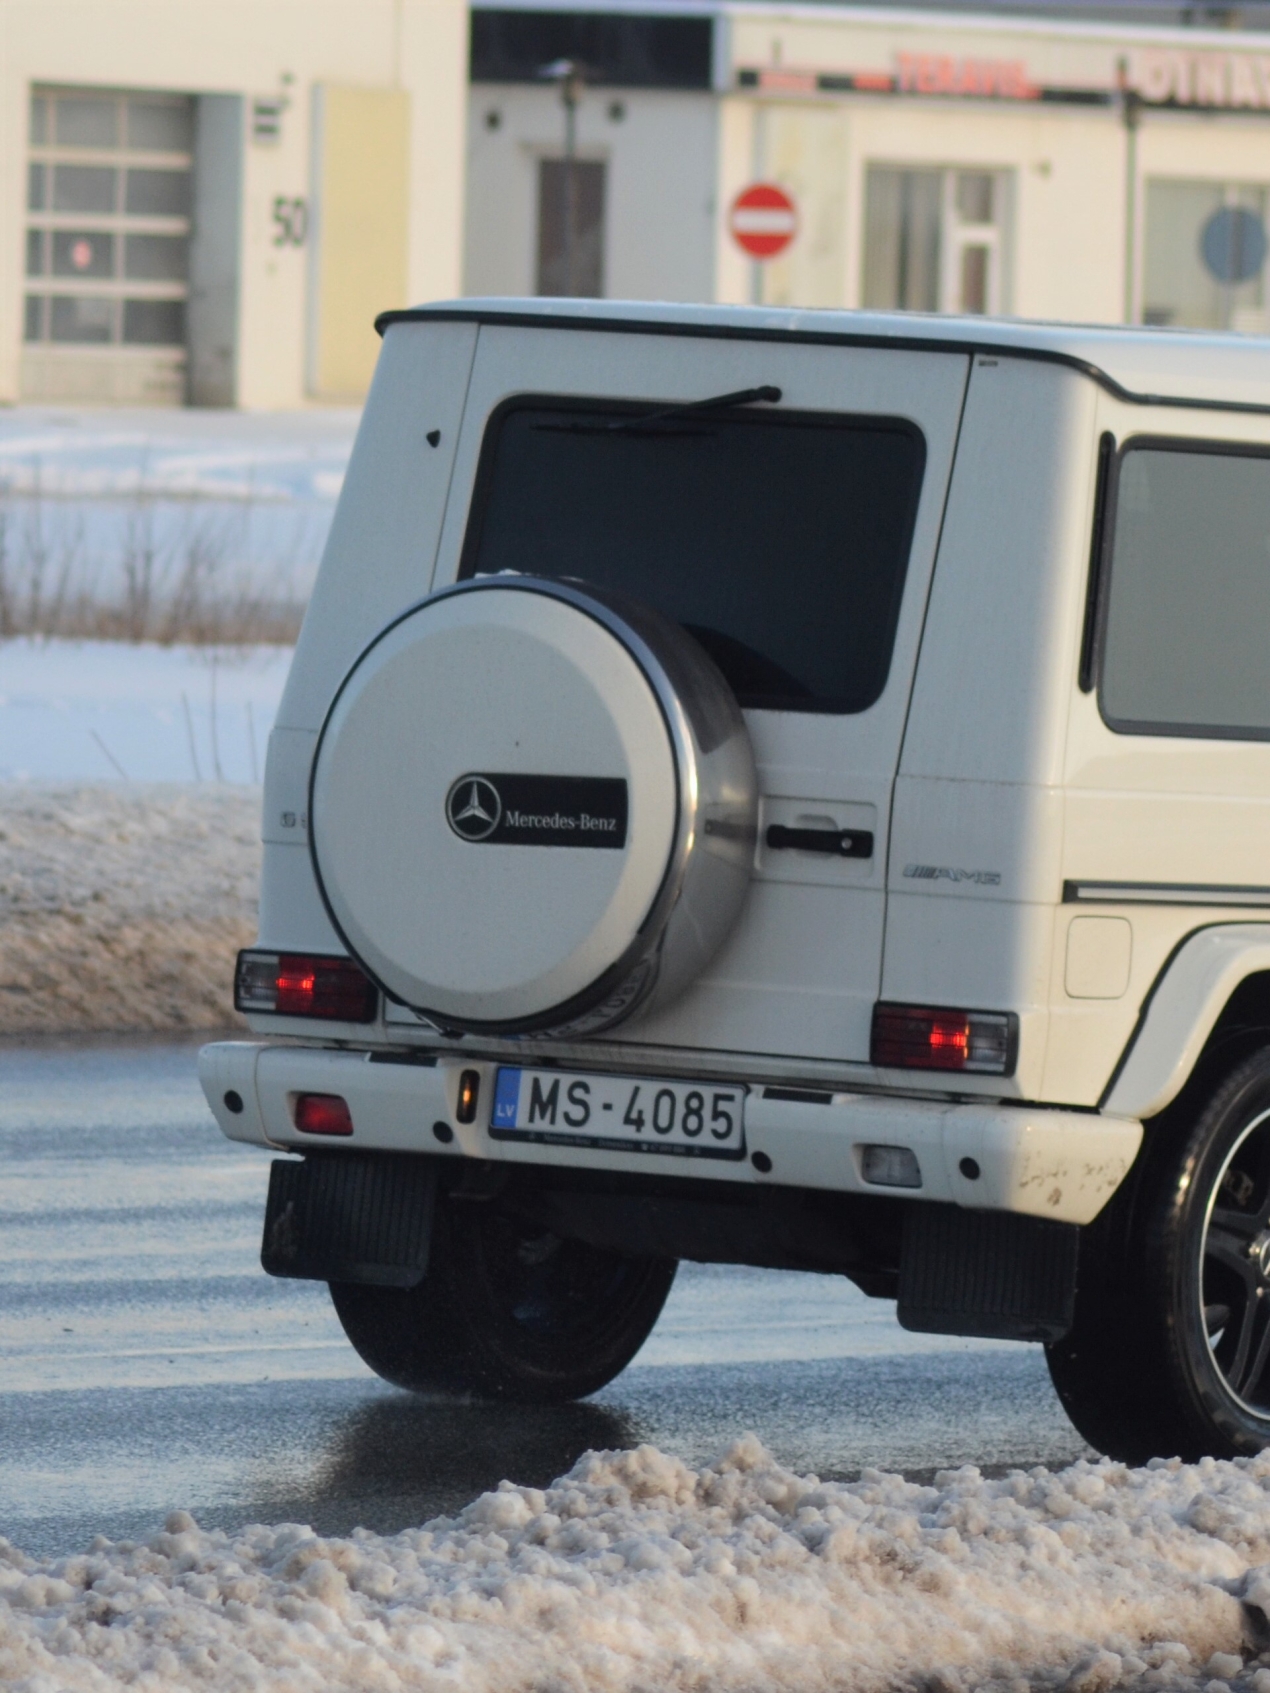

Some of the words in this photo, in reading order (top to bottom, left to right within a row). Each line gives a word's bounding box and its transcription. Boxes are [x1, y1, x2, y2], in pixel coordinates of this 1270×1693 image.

[272, 195, 309, 247] 50
[505, 810, 617, 831] Mercedes-Benz
[496, 1103, 516, 1118] LV
[528, 1076, 736, 1141] MS-4085
